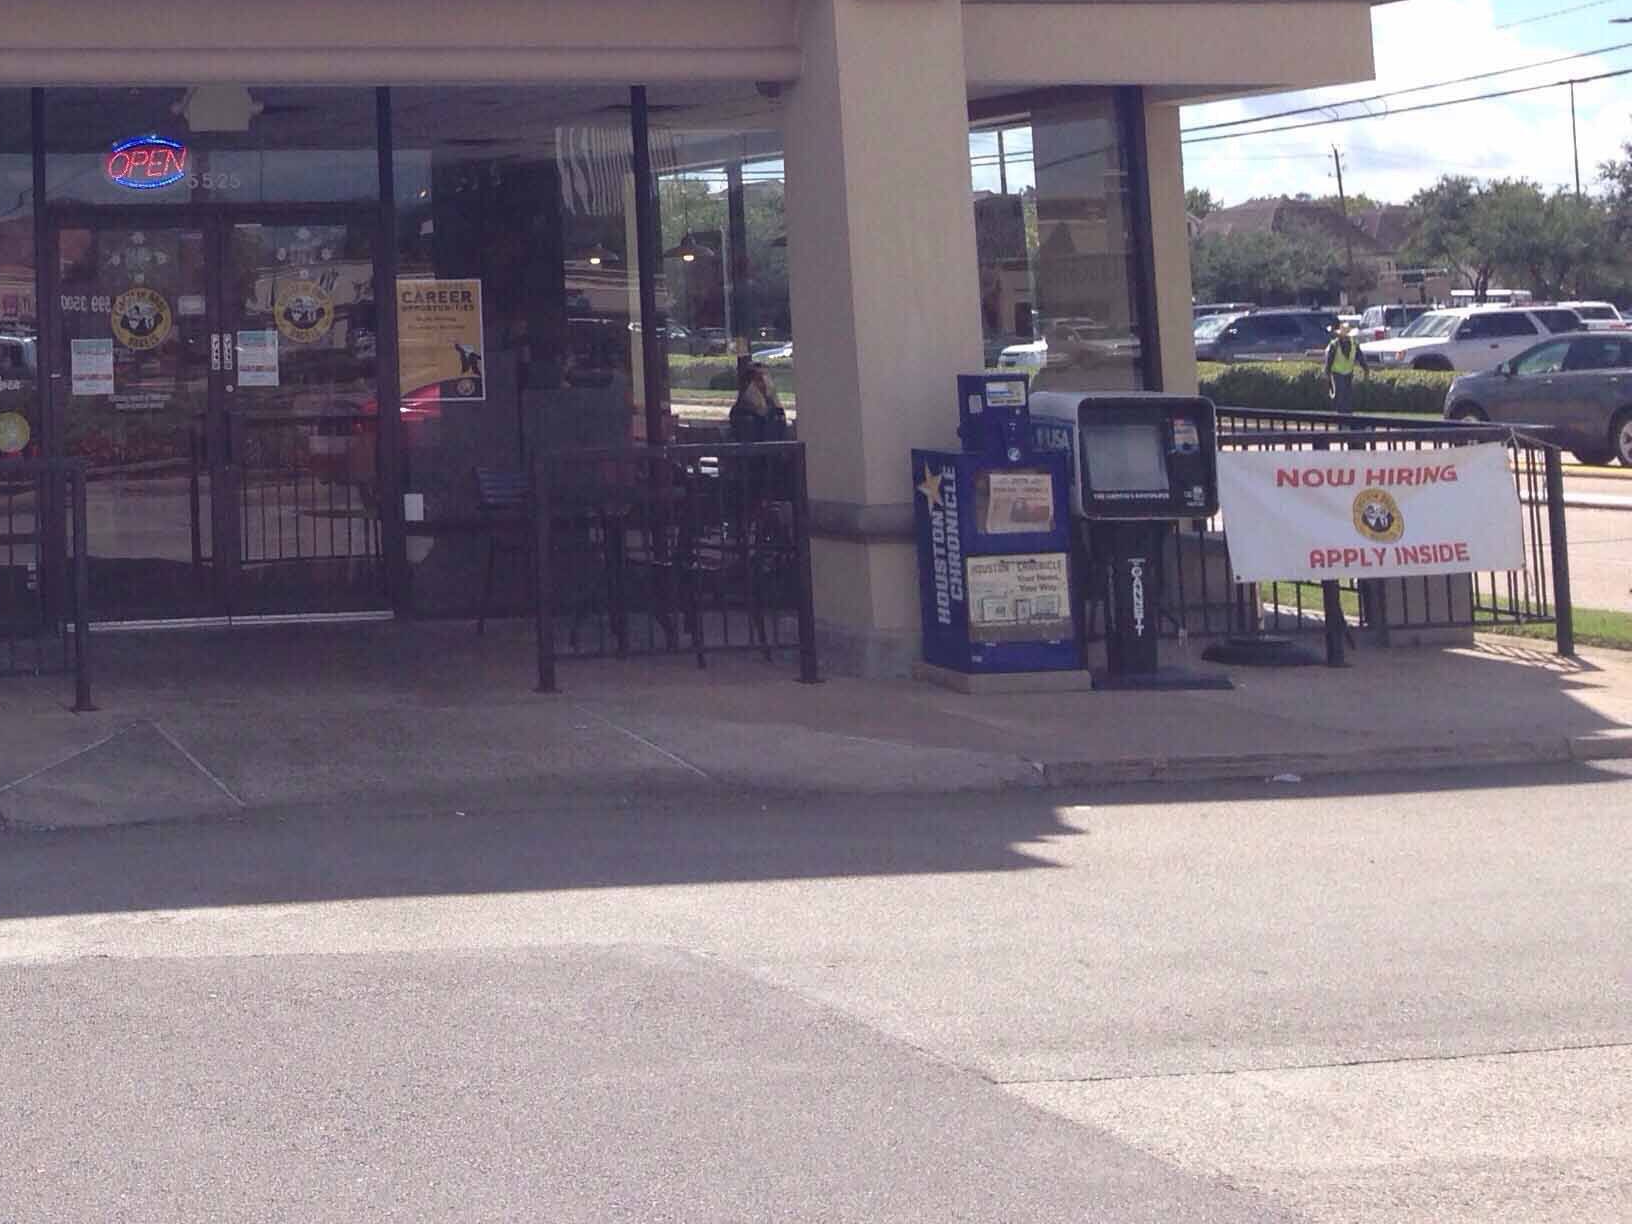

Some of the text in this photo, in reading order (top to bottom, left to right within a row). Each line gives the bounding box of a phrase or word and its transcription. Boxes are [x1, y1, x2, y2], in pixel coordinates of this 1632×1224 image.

[108, 147, 188, 180] OPEN
[400, 290, 473, 304] CAREER
[1276, 464, 1458, 488] NOW HIRING
[941, 464, 964, 601] CHRONICLE
[930, 509, 952, 625] HOUSTON
[1309, 542, 1470, 568] APPLY INSIDE
